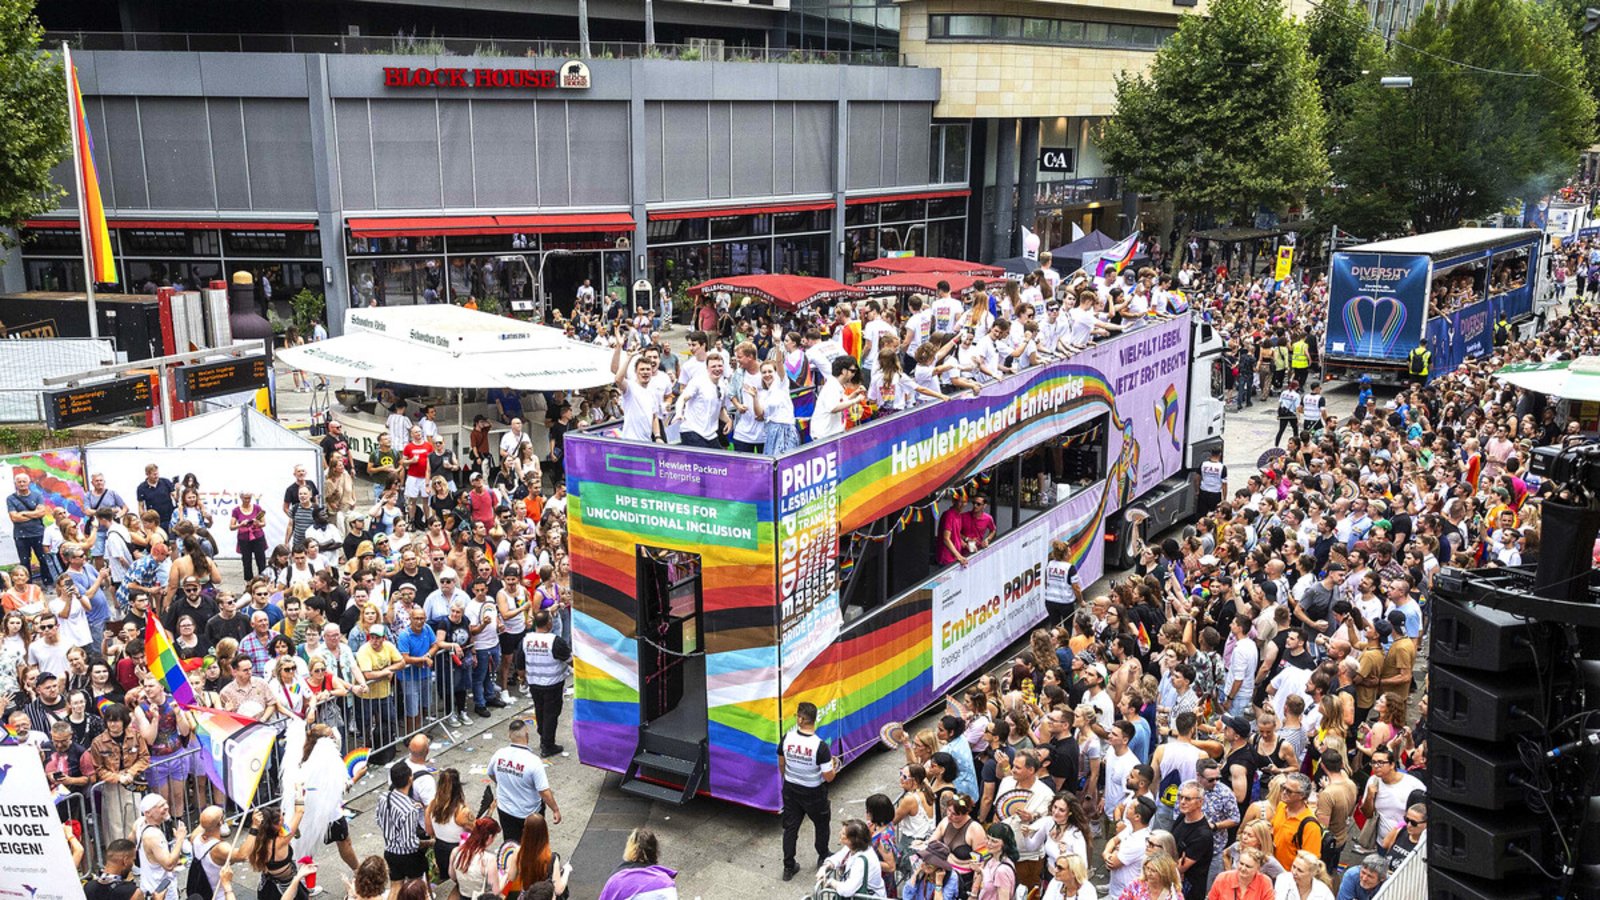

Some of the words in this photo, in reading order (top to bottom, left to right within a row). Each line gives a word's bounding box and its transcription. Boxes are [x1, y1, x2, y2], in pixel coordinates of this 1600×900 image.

[383, 67, 469, 88] BLOCK
[472, 68, 557, 89] HOUSE
[1043, 151, 1068, 168] C&A
[1351, 266, 1411, 278] DIVERSITY
[701, 283, 734, 293] FELLBACHER
[797, 291, 830, 309] FELLBACHER
[1119, 336, 1157, 367] VIELFALT
[1115, 370, 1139, 396] JETZT
[1140, 361, 1159, 385] ERST
[1160, 350, 1187, 376] RECHT!
[891, 423, 956, 476] Hewlet
[958, 395, 1018, 448] Packard
[1020, 374, 1085, 421] Enterprise
[658, 459, 692, 472] Hewlett
[693, 463, 728, 476] Packard
[659, 470, 701, 483] Enterprise
[781, 451, 837, 497] PRIDE
[615, 494, 639, 508] HPE
[640, 498, 690, 516] STRIVES
[692, 505, 718, 519] FOR
[780, 484, 823, 514] LESBIAN
[586, 506, 684, 532] UNCONDITIONAL
[686, 520, 752, 540] INCLUSION
[781, 513, 798, 621] PRIDE
[795, 533, 809, 607] QUEER
[941, 595, 1001, 651] Embrace
[1004, 562, 1042, 608] PRIDE
[941, 649, 961, 669] Engage
[0, 804, 49, 818] LISTEN
[4, 823, 50, 837] VOGEL
[0, 841, 45, 855] EIGEN!
